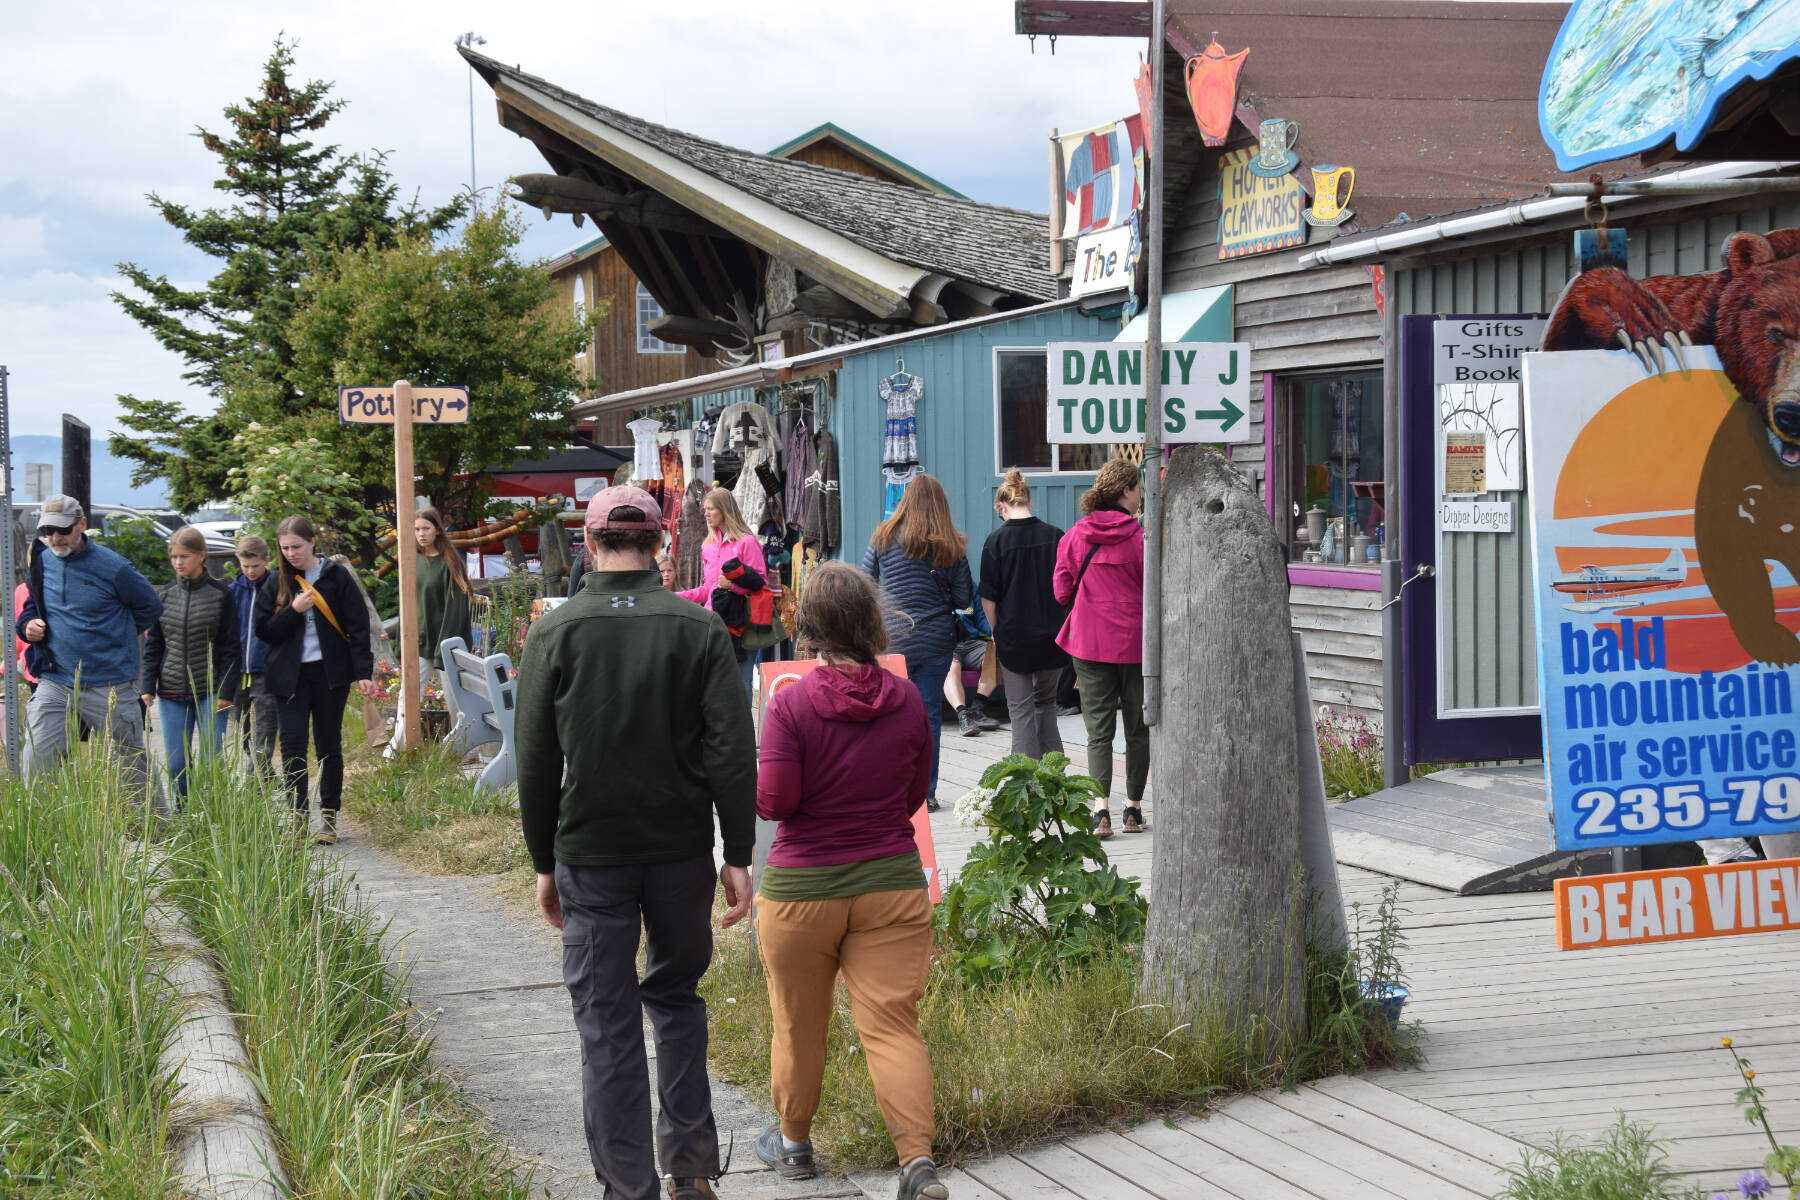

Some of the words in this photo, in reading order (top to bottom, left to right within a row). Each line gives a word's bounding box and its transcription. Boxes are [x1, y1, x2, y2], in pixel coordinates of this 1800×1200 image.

[1223, 190, 1298, 238] CLAYWORKS
[1083, 243, 1118, 283] The
[1461, 322, 1524, 337] Gifts
[1218, 350, 1238, 385] J
[347, 390, 444, 422] Pottry
[1443, 505, 1470, 529] Dipper
[1473, 505, 1509, 530] Designs
[1560, 616, 1667, 675] bald
[1564, 664, 1793, 730] mountain
[1567, 733, 1627, 786] air
[1636, 724, 1796, 780] service
[1576, 776, 1800, 836] 235-79
[1567, 876, 1695, 945] BEAR
